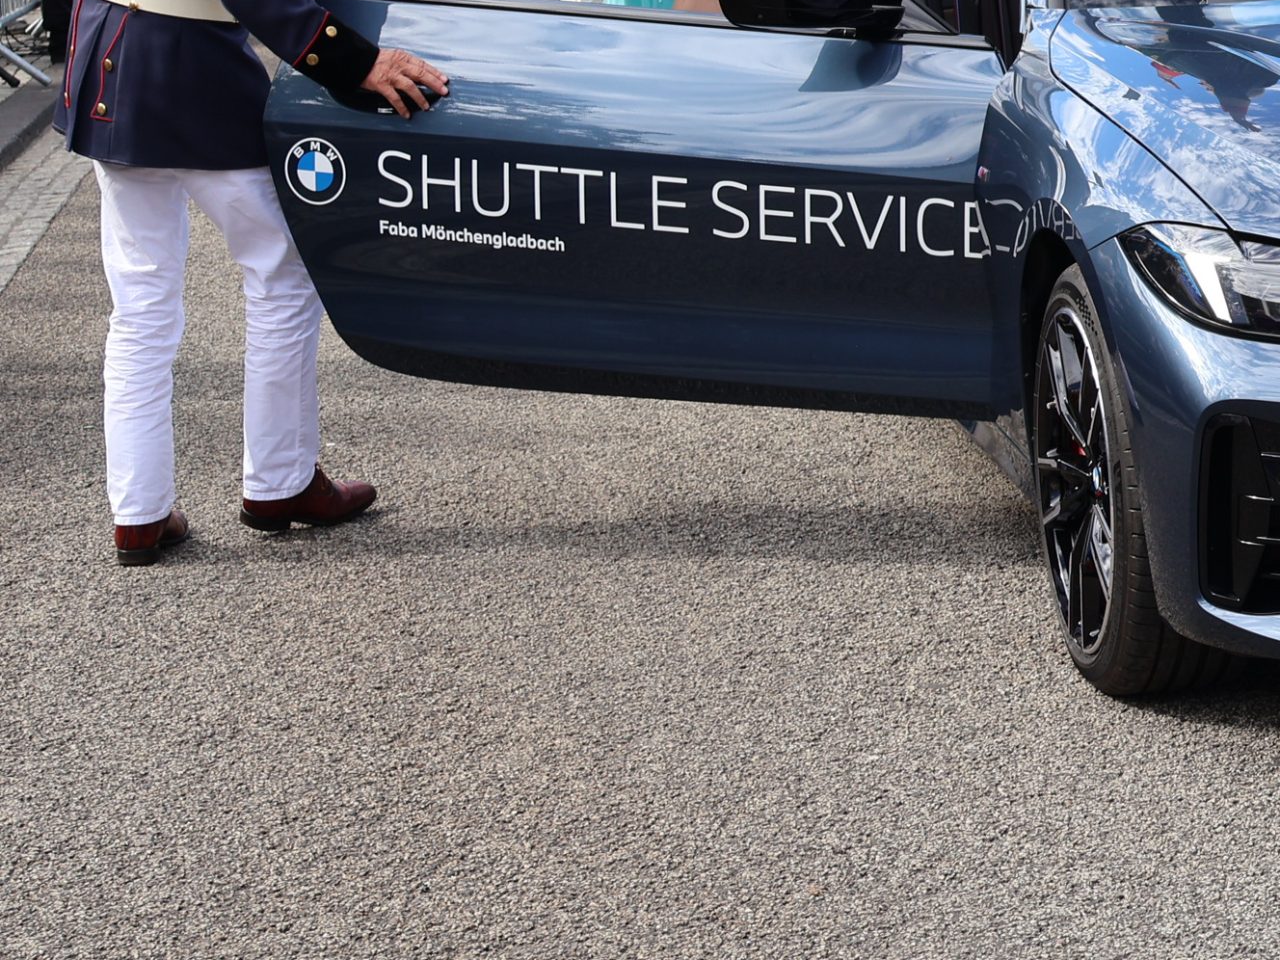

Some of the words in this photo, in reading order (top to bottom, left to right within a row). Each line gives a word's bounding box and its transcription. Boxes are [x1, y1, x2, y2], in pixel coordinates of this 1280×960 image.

[377, 149, 690, 235] SHUTTLE
[711, 180, 984, 259] SERVICE
[379, 219, 419, 239] Faba
[422, 224, 566, 252] Mönchengladbach
